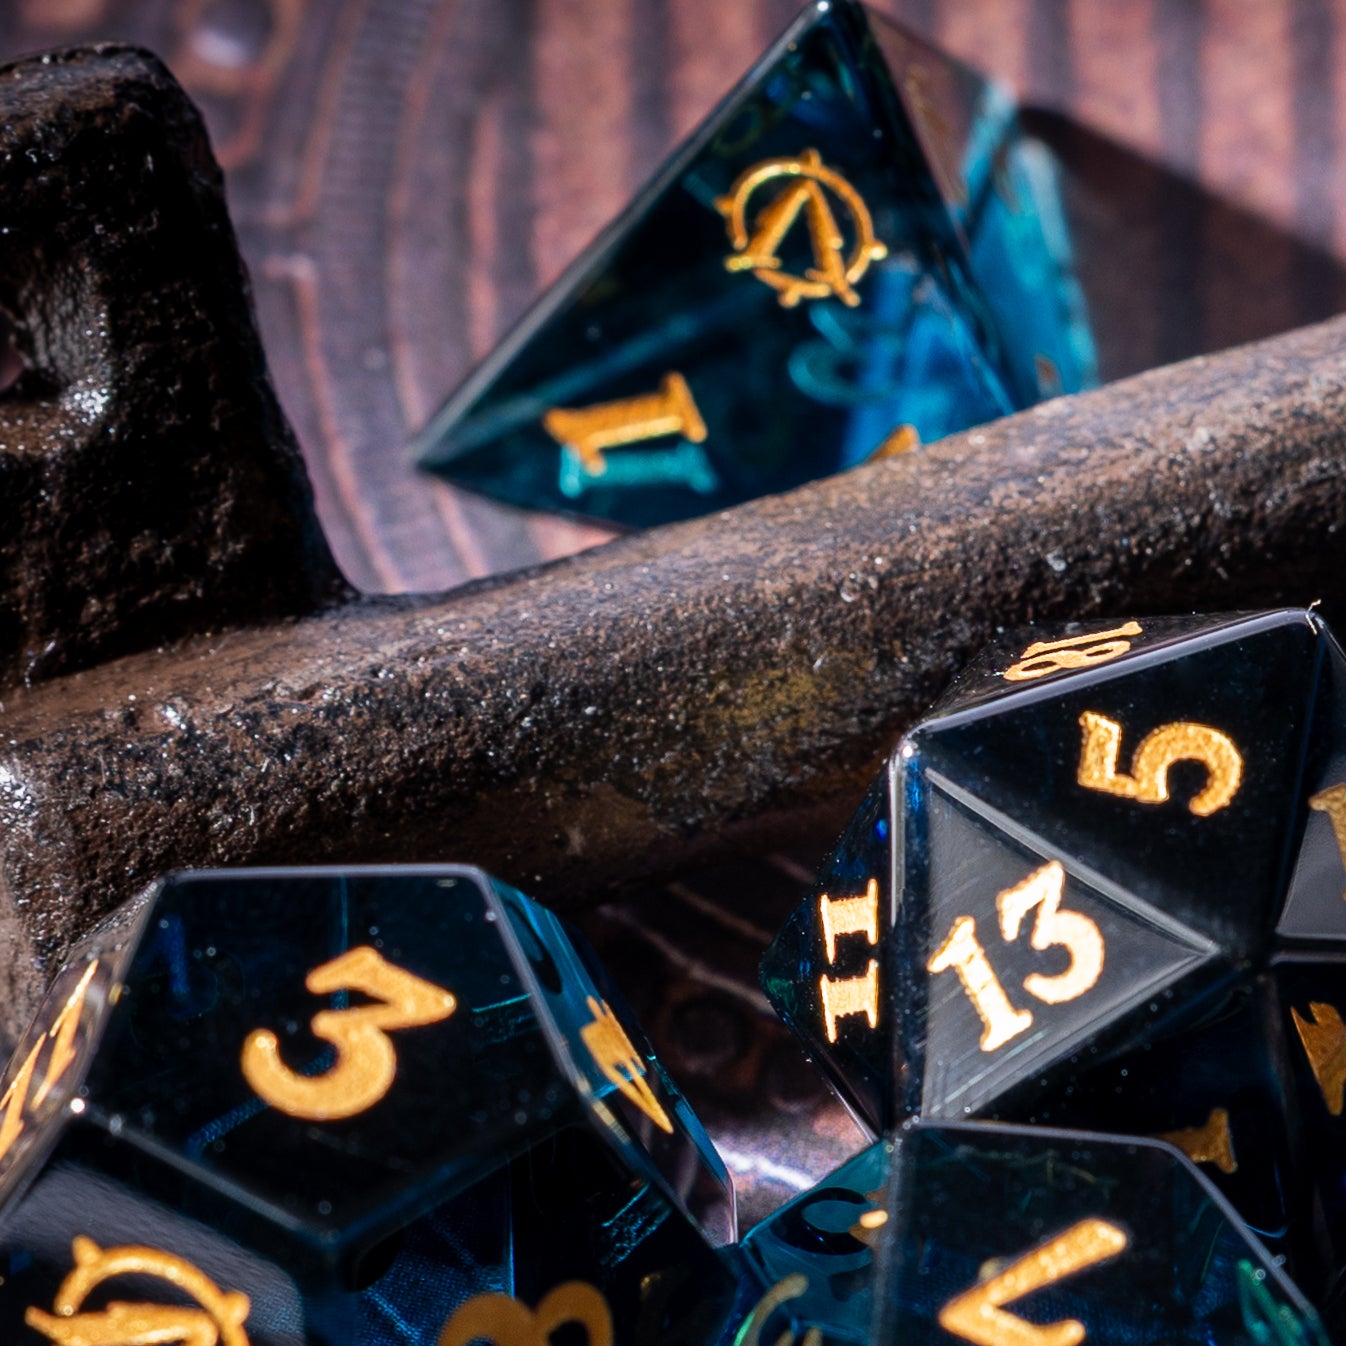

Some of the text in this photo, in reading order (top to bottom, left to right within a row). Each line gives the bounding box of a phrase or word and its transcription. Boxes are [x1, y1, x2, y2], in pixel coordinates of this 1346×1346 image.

[1002, 620, 1143, 683] 18
[1076, 709, 1245, 818] 5
[926, 860, 1106, 1053] 13
[240, 945, 457, 1122] 3
